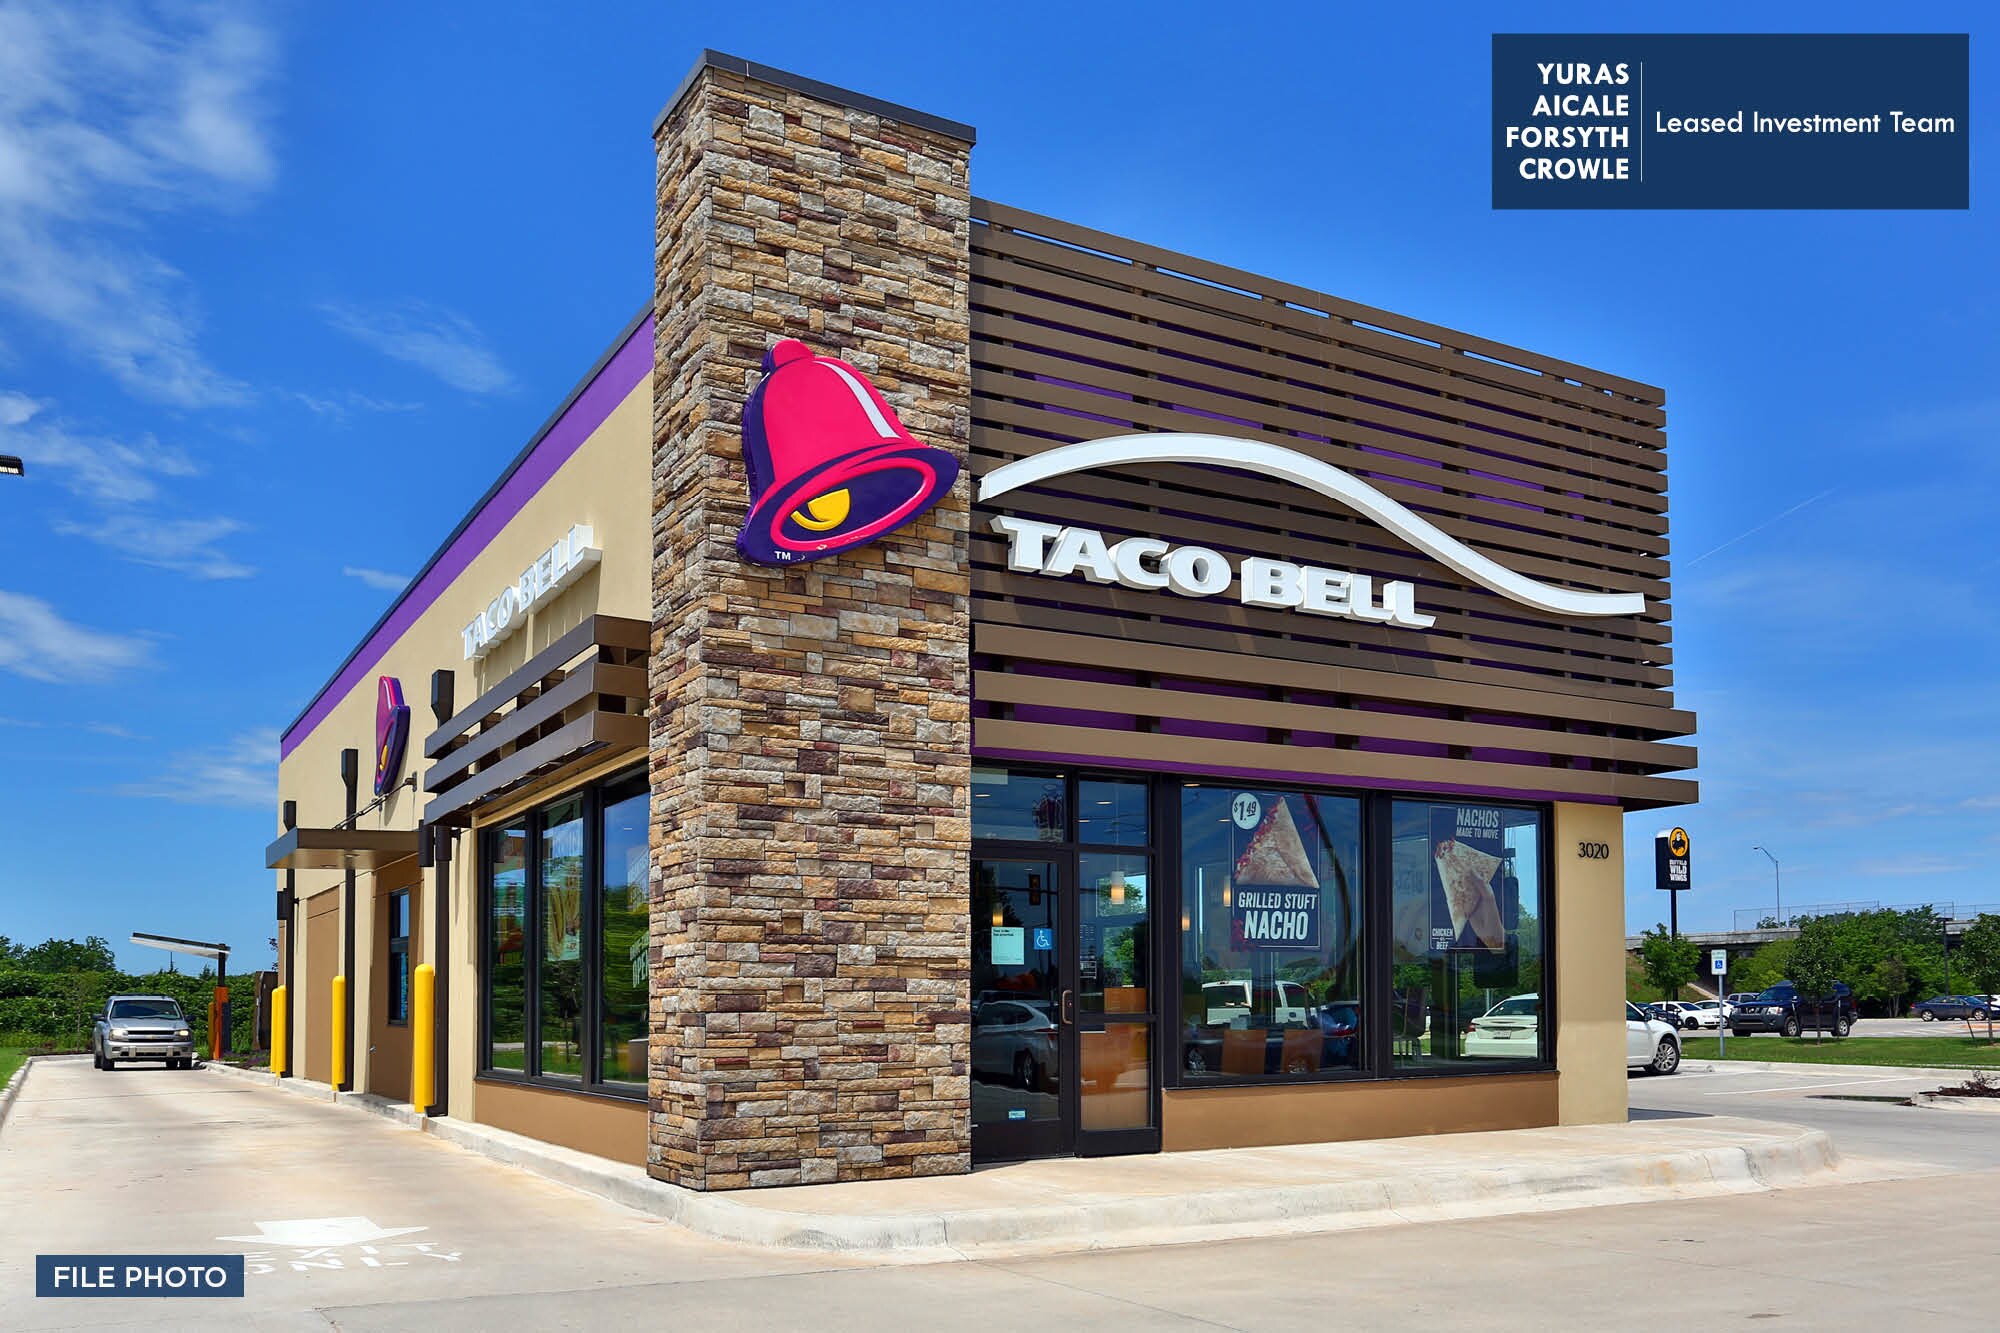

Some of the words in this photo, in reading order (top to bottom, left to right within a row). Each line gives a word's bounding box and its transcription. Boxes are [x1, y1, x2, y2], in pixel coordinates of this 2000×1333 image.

[774, 551, 791, 561] TM
[990, 516, 1232, 597] TACO
[1241, 557, 1436, 629] BELL
[462, 586, 516, 660] TACO
[519, 524, 600, 614] BELL
[1457, 808, 1499, 828] NACHOS
[1456, 827, 1473, 838] MADE
[1474, 829, 1482, 838] TO
[1483, 829, 1499, 839] MOVE
[1578, 842, 1609, 860] 3020
[1669, 865, 1687, 874] WILD
[1669, 874, 1687, 882] WINGS
[1238, 892, 1281, 909] GRILLED
[1284, 893, 1317, 910] STUFT
[1244, 910, 1309, 940] NACHO
[1436, 941, 1449, 950] BEEF
